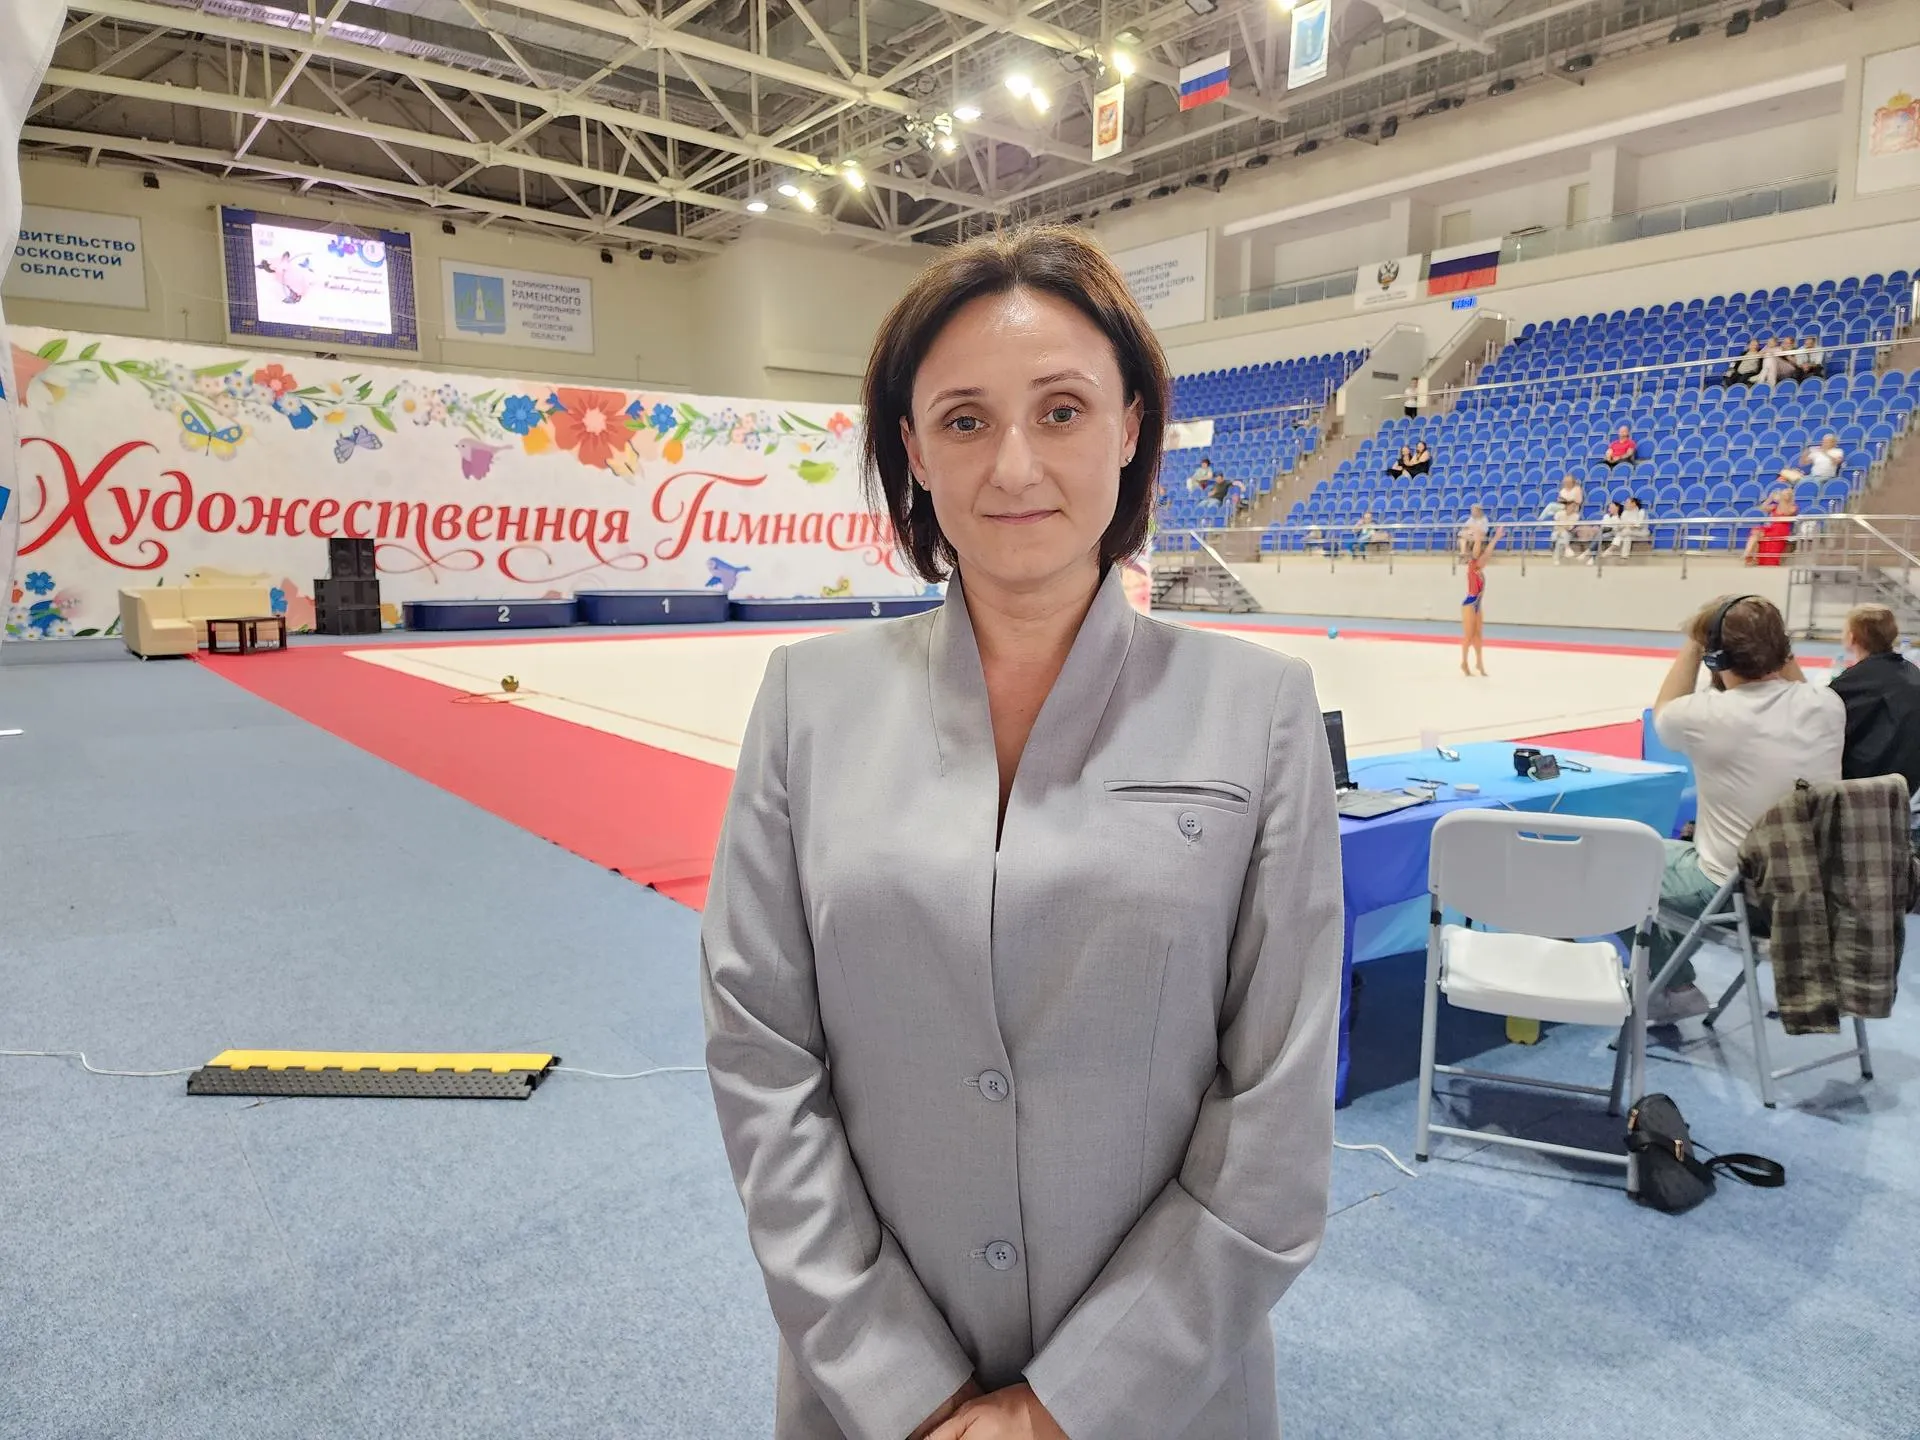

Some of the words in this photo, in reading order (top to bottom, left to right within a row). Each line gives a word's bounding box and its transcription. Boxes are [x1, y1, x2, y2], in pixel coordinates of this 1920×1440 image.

[20, 262, 104, 280] ОБЛАСТИ
[511, 280, 581, 294] АДМИНИСТРАЦИЯ
[1167, 276, 1194, 288] СПОРТА
[511, 290, 582, 307] РАМЕНСКОГО
[530, 331, 567, 342] ОБЛАСТИ
[17, 437, 648, 583] Художественная
[497, 605, 511, 623] 2
[662, 597, 671, 614] 1
[871, 601, 881, 617] 3
